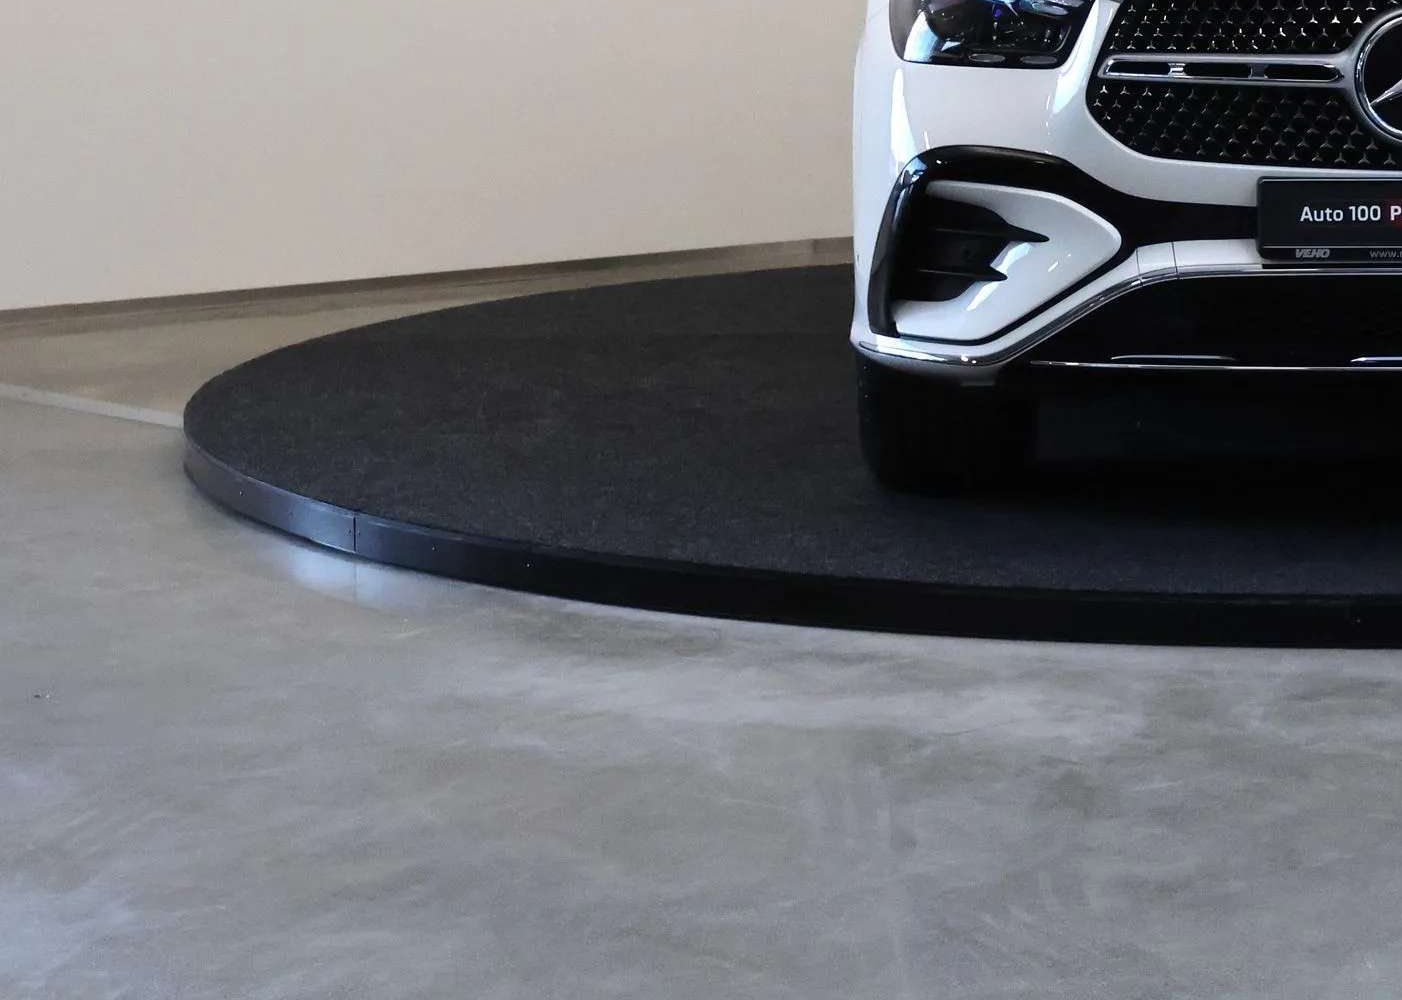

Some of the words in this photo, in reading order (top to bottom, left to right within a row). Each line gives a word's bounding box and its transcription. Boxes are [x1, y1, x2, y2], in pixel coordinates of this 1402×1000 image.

[1300, 206, 1344, 222] Auto
[1348, 205, 1381, 221] 100
[1295, 248, 1331, 259] VEHO
